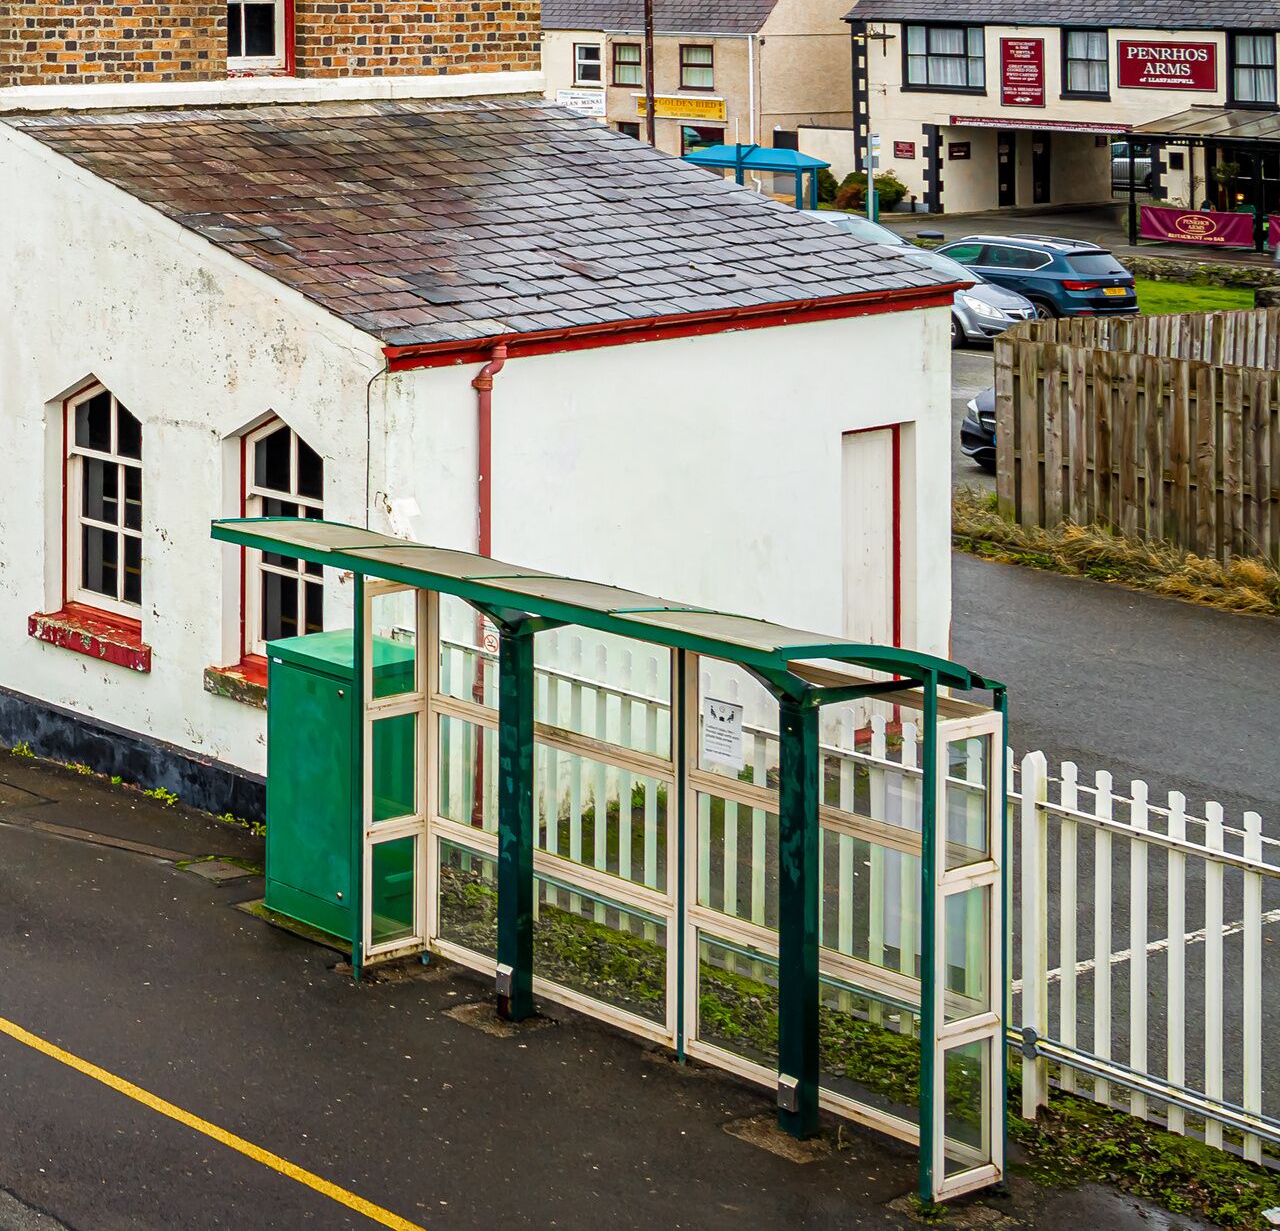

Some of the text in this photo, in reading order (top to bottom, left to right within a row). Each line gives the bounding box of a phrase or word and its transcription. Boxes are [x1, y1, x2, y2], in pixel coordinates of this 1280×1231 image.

[1126, 47, 1208, 61] PENRHOS
[1143, 63, 1191, 76] ARMS
[659, 99, 717, 108] GOLDEN BIRD
